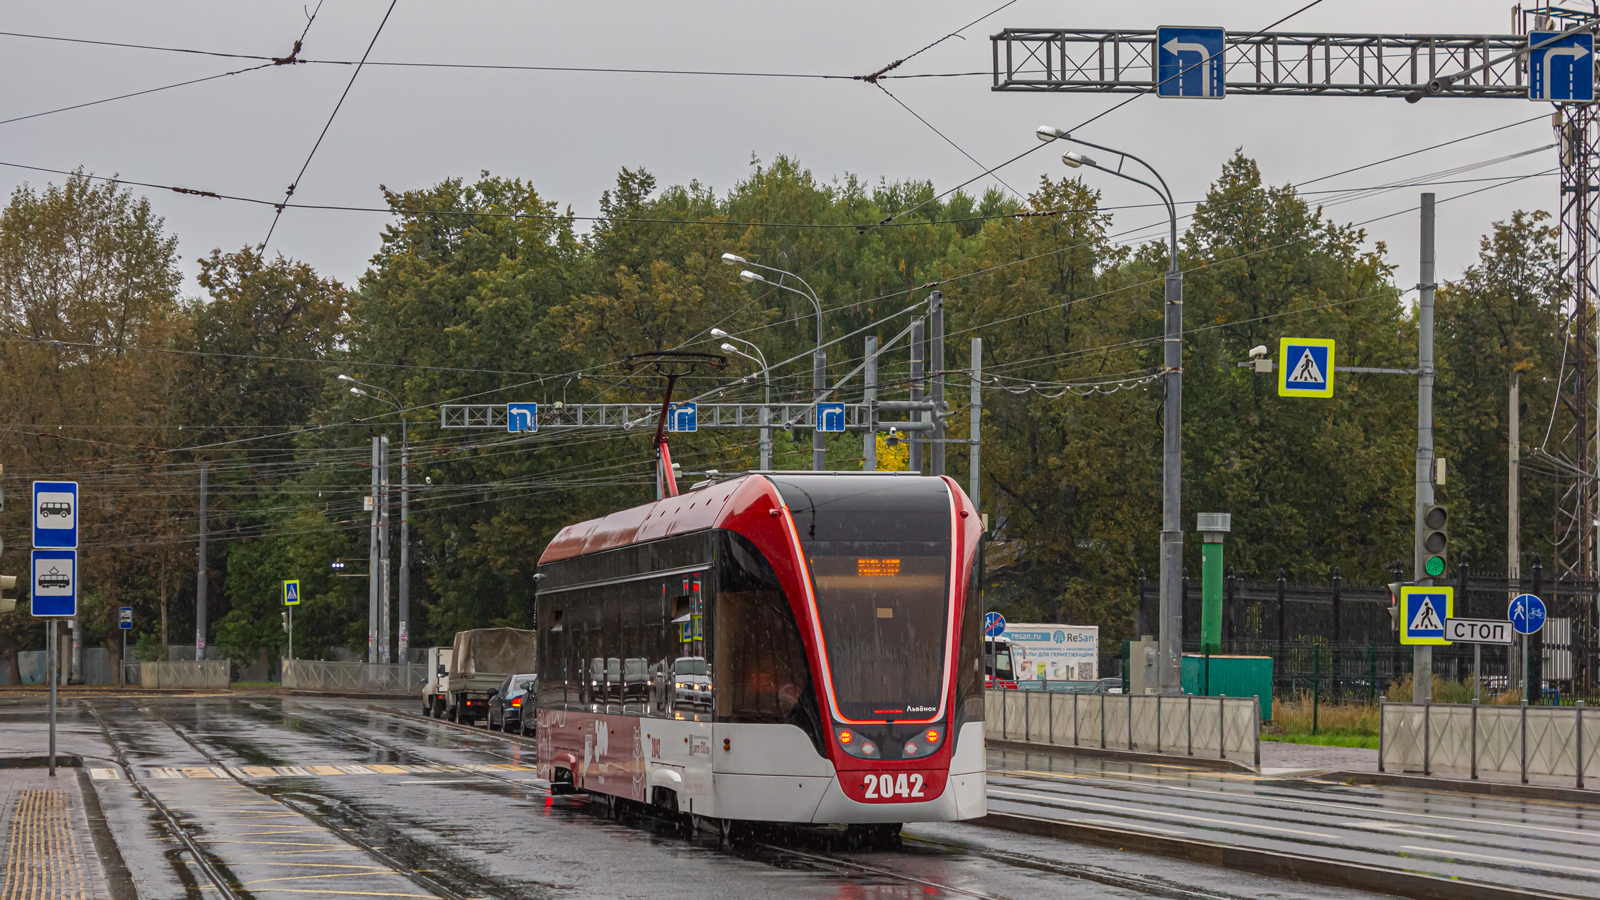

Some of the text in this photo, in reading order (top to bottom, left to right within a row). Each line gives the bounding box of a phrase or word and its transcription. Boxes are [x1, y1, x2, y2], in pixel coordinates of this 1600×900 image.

[1067, 633, 1094, 642] ReSan
[1454, 622, 1504, 640] СТОП
[864, 773, 924, 799] 2042
